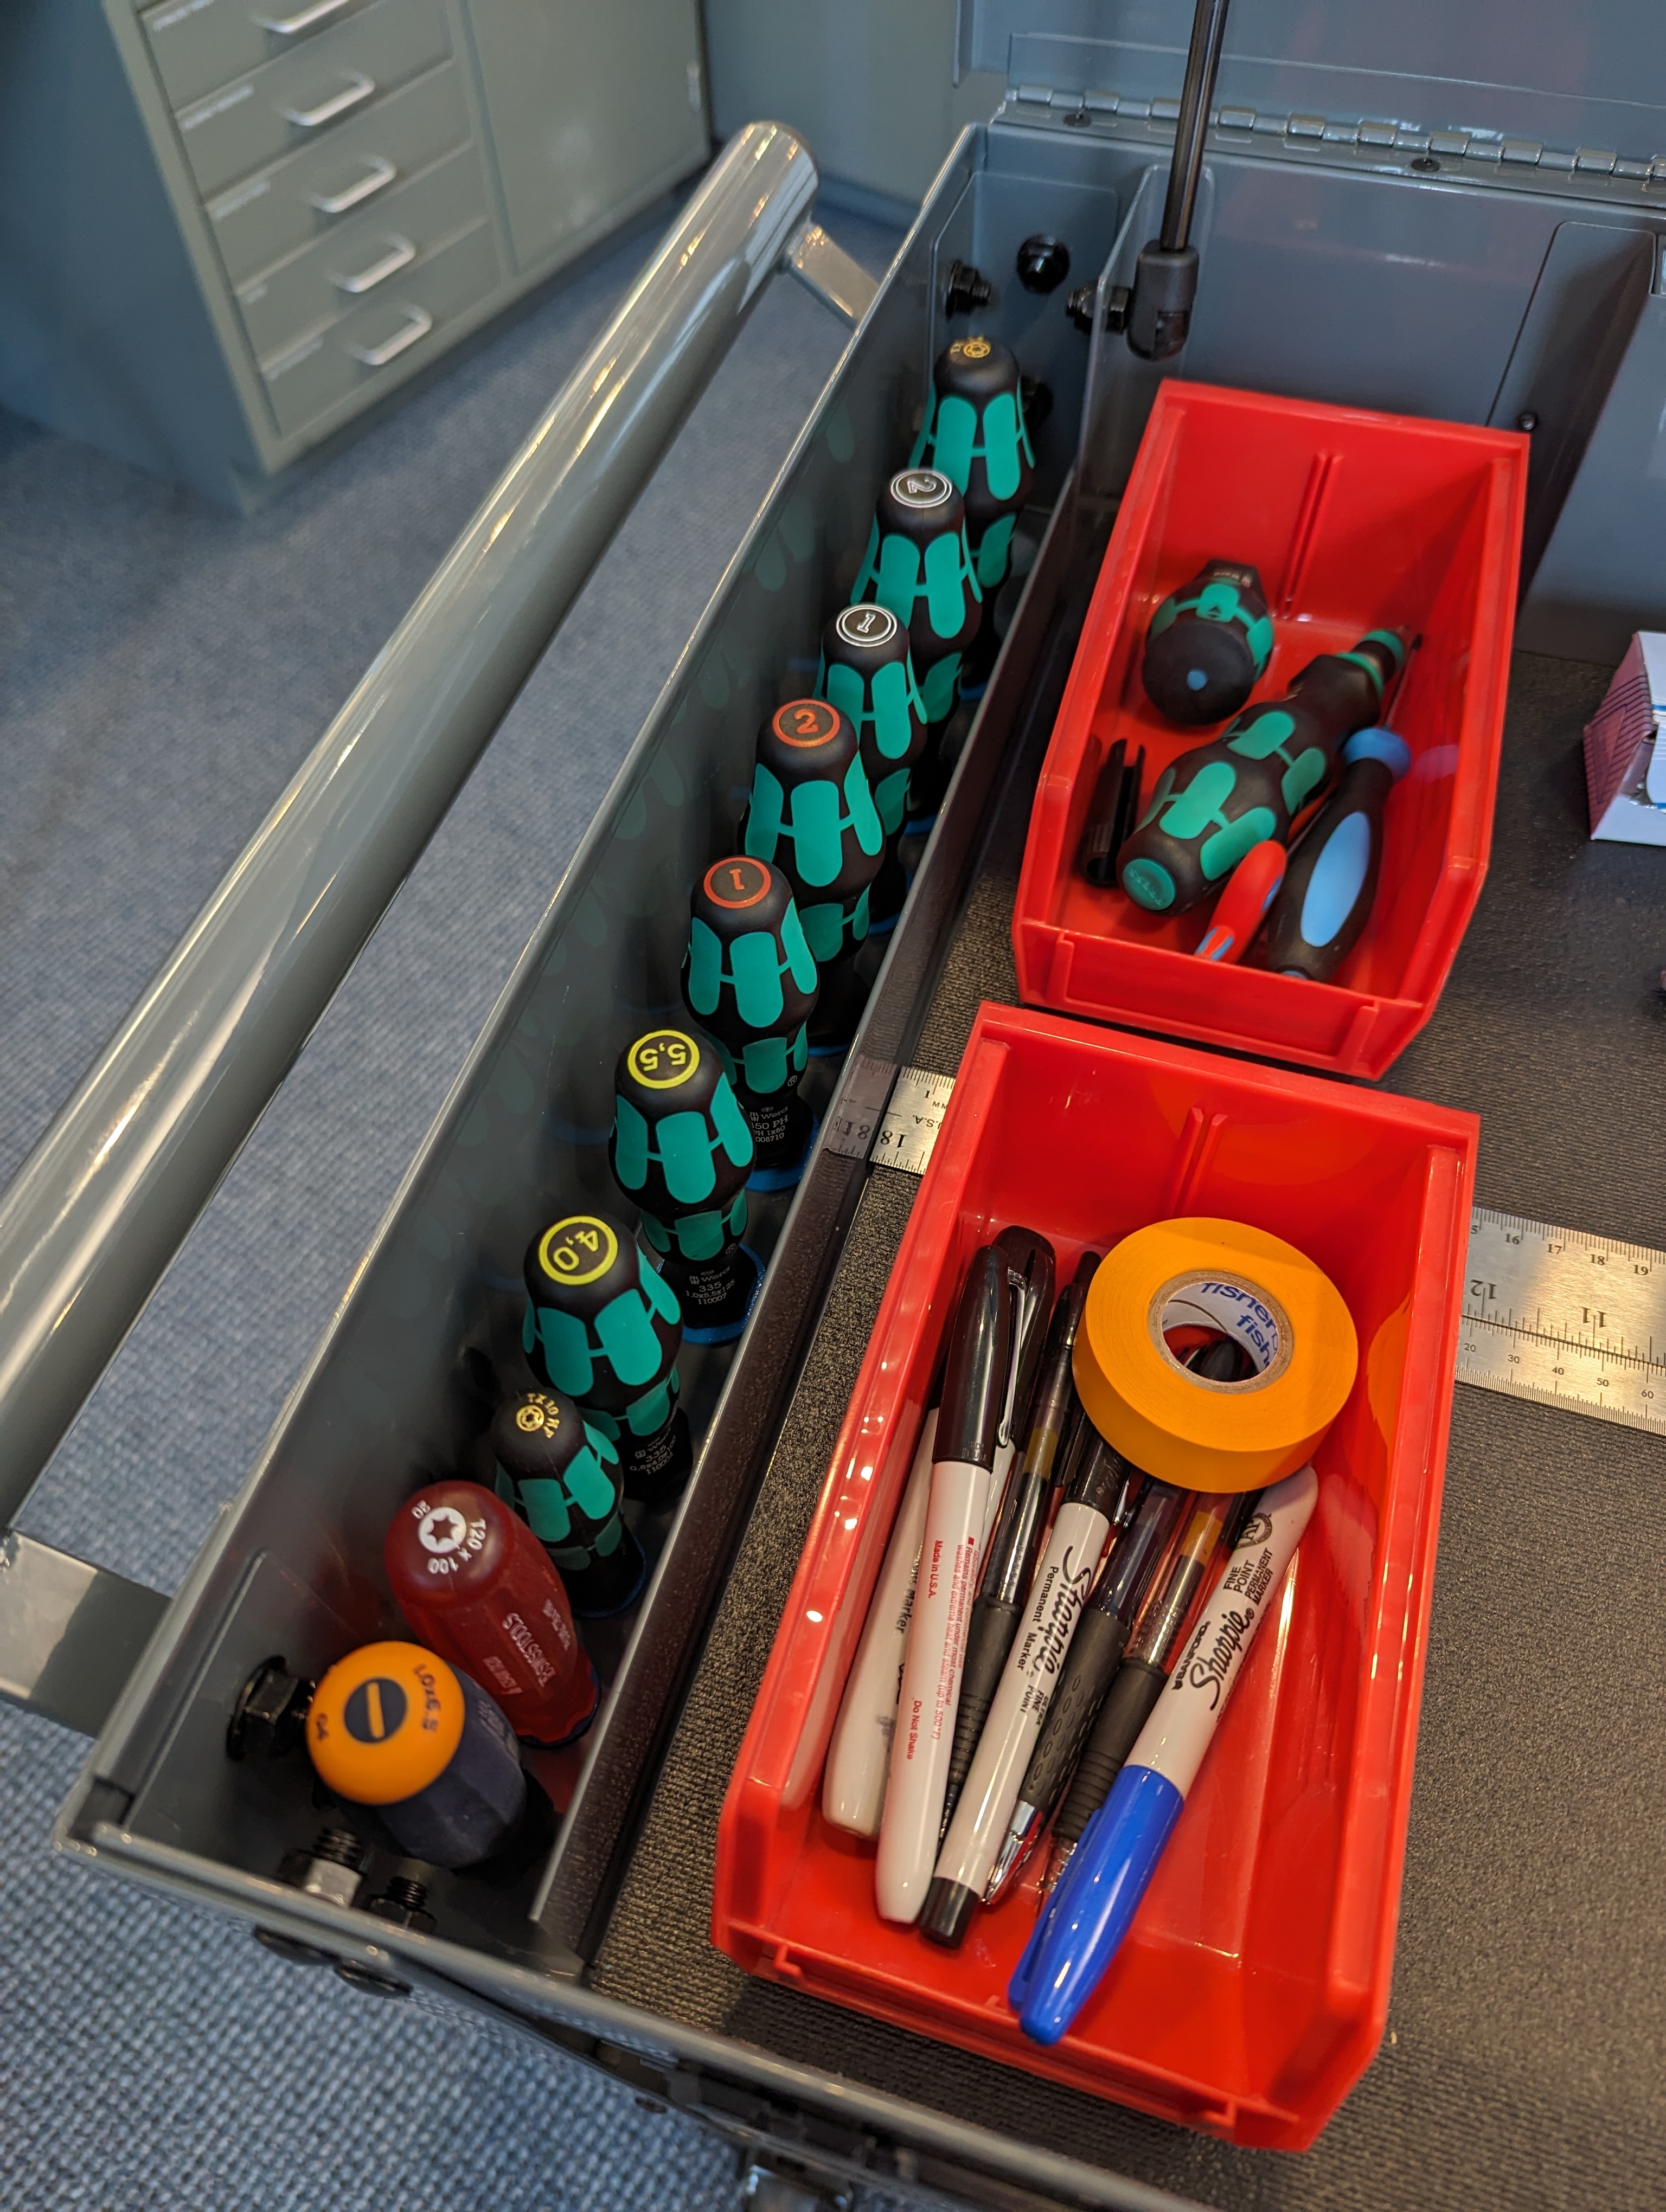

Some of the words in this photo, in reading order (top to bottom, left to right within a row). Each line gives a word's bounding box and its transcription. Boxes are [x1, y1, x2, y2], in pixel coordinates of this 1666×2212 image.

[906, 475, 937, 494] 2
[857, 612, 876, 633] 1
[793, 708, 819, 734] 2
[729, 868, 746, 890] 1
[640, 1042, 686, 1072] 5,5
[924, 1090, 931, 1099] 1
[767, 1125, 785, 1136] 1x80
[772, 1114, 789, 1128] PH
[912, 1114, 942, 1130] .S.A.
[880, 1130, 907, 1149] 18
[553, 1229, 599, 1271] 4,0
[1505, 1233, 1521, 1245] 16
[1546, 1243, 1562, 1255] 17
[1590, 1253, 1606, 1266] 18
[1633, 1264, 1649, 1276] 19
[697, 1291, 727, 1305] 110007
[699, 1281, 722, 1293] 335
[1470, 1278, 1497, 1300] 12
[1580, 1307, 1607, 1328] 11
[1236, 1314, 1271, 1369] fish
[1464, 1343, 1476, 1352] 20
[1507, 1354, 1520, 1364] 30
[1552, 1366, 1565, 1376] 40
[1597, 1378, 1610, 1387] 50
[1641, 1388, 1655, 1399] 60
[645, 1444, 667, 1463] 335
[466, 1517, 486, 1551] T20
[457, 1547, 473, 1562] x
[932, 1540, 944, 1563] Made
[962, 1546, 973, 1580] Remains
[427, 1556, 459, 1574] 100
[931, 1564, 940, 1572] in
[1233, 1559, 1255, 1593] POINT
[1244, 1547, 1273, 1599] PERMANENT
[952, 1574, 960, 1590] and
[1223, 1566, 1242, 1590] FINE
[1251, 1567, 1273, 1606] MARKER
[956, 1580, 968, 1623] permanent
[1032, 1566, 1060, 1623] Permanent
[895, 1589, 916, 1634] Marker
[943, 1638, 951, 1656] and
[950, 1647, 958, 1668] most
[1017, 1632, 1037, 1671] Marker
[945, 1668, 955, 1706] chemical
[913, 1700, 922, 1713] Do
[936, 1700, 944, 1708] to
[1032, 1689, 1045, 1713] FINE
[911, 1715, 921, 1731] Not
[906, 1731, 919, 1760] Shake
